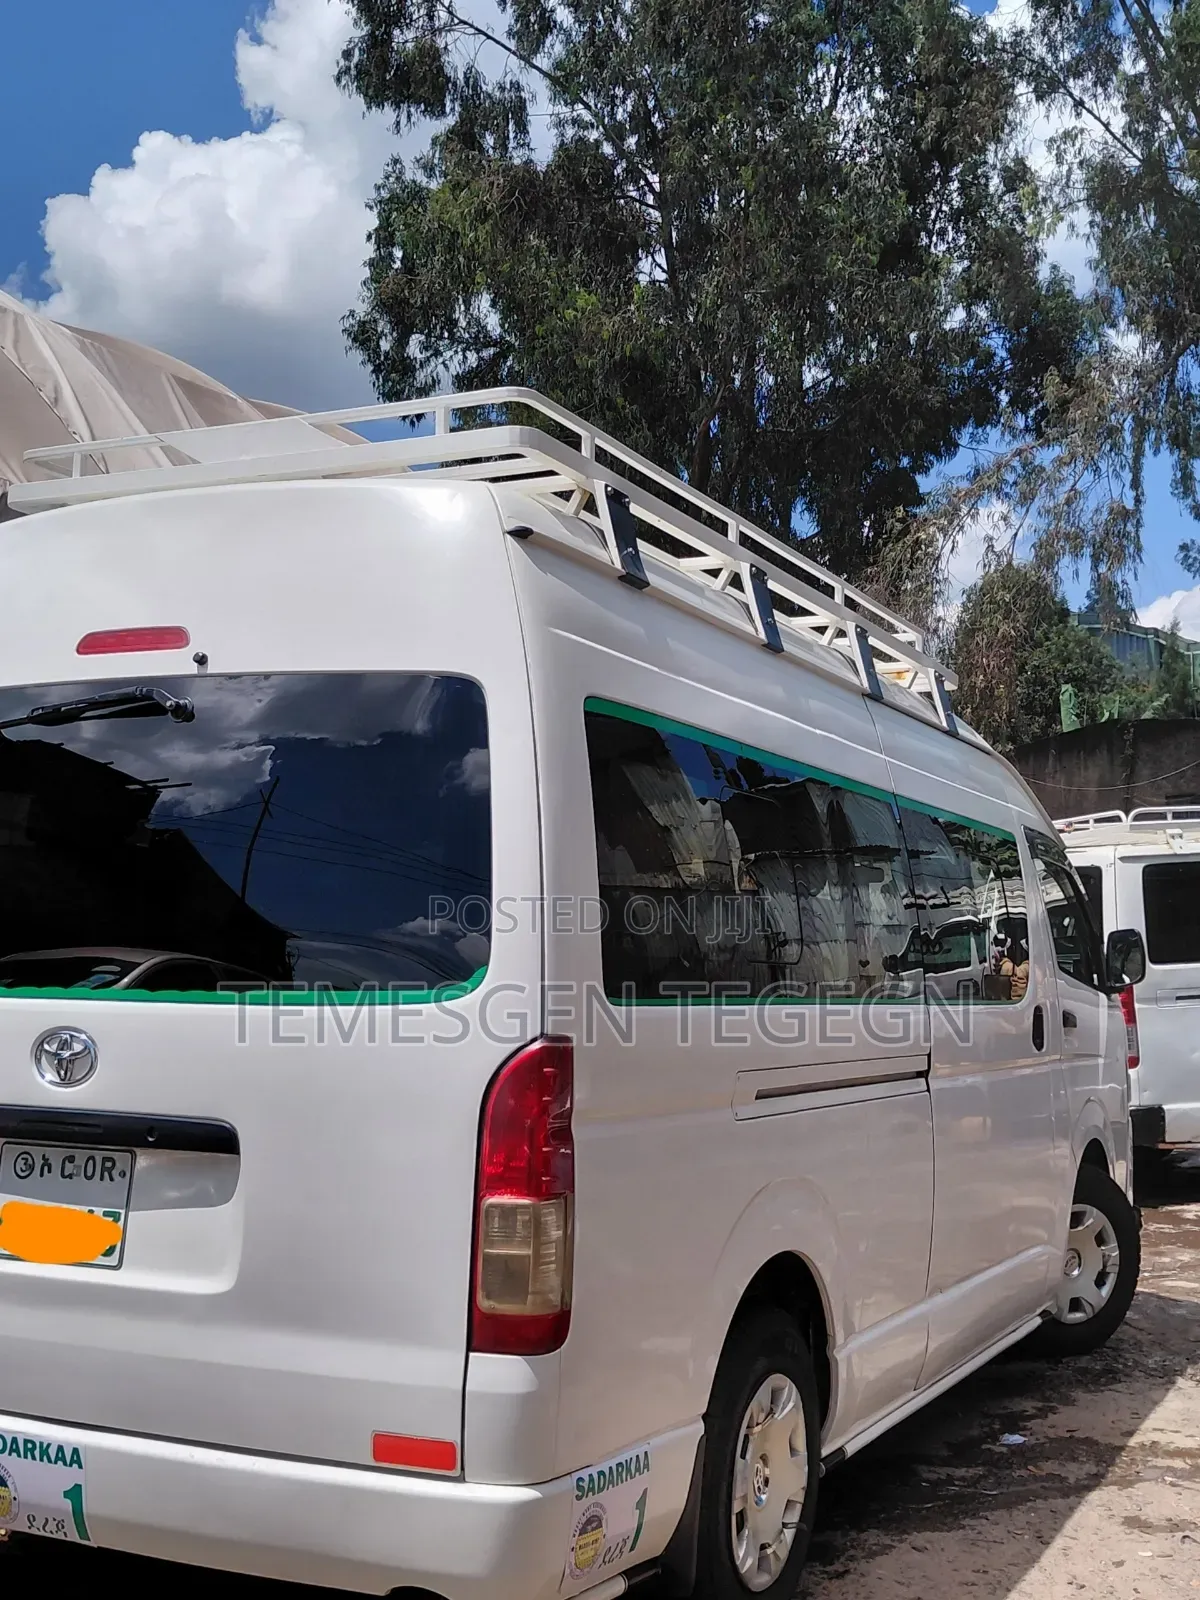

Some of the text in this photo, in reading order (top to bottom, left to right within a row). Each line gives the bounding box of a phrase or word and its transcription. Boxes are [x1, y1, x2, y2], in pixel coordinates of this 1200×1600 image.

[575, 1451, 651, 1502] SADARKAA
[63, 1483, 91, 1542] 1
[629, 1487, 649, 1553] 1
